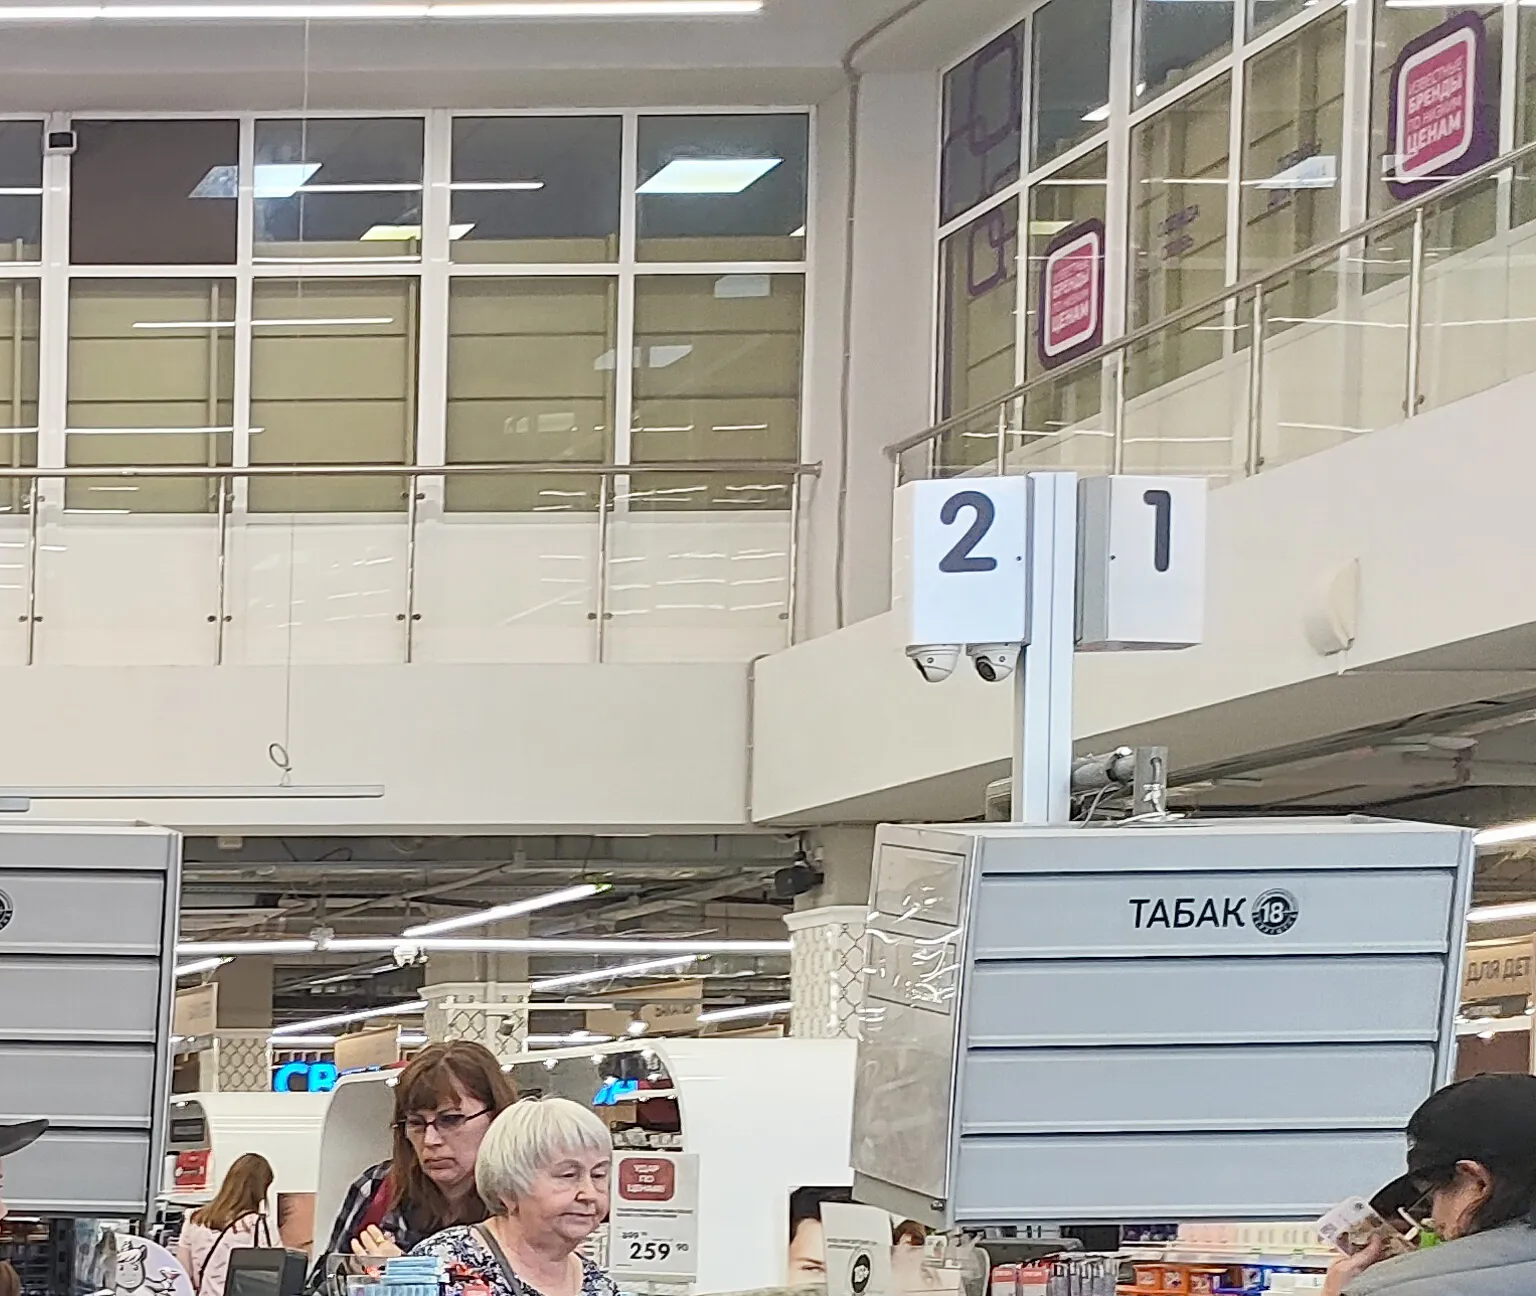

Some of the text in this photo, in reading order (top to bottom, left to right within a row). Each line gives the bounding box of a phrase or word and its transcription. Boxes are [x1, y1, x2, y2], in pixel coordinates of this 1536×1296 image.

[1408, 73, 1463, 115] БРЕНДЫ
[1407, 110, 1462, 156] ЦЕНАМ
[938, 490, 998, 573] 2
[1142, 490, 1171, 572] 1
[1128, 897, 1247, 928] ТАБАК
[630, 1242, 670, 1260] 259
